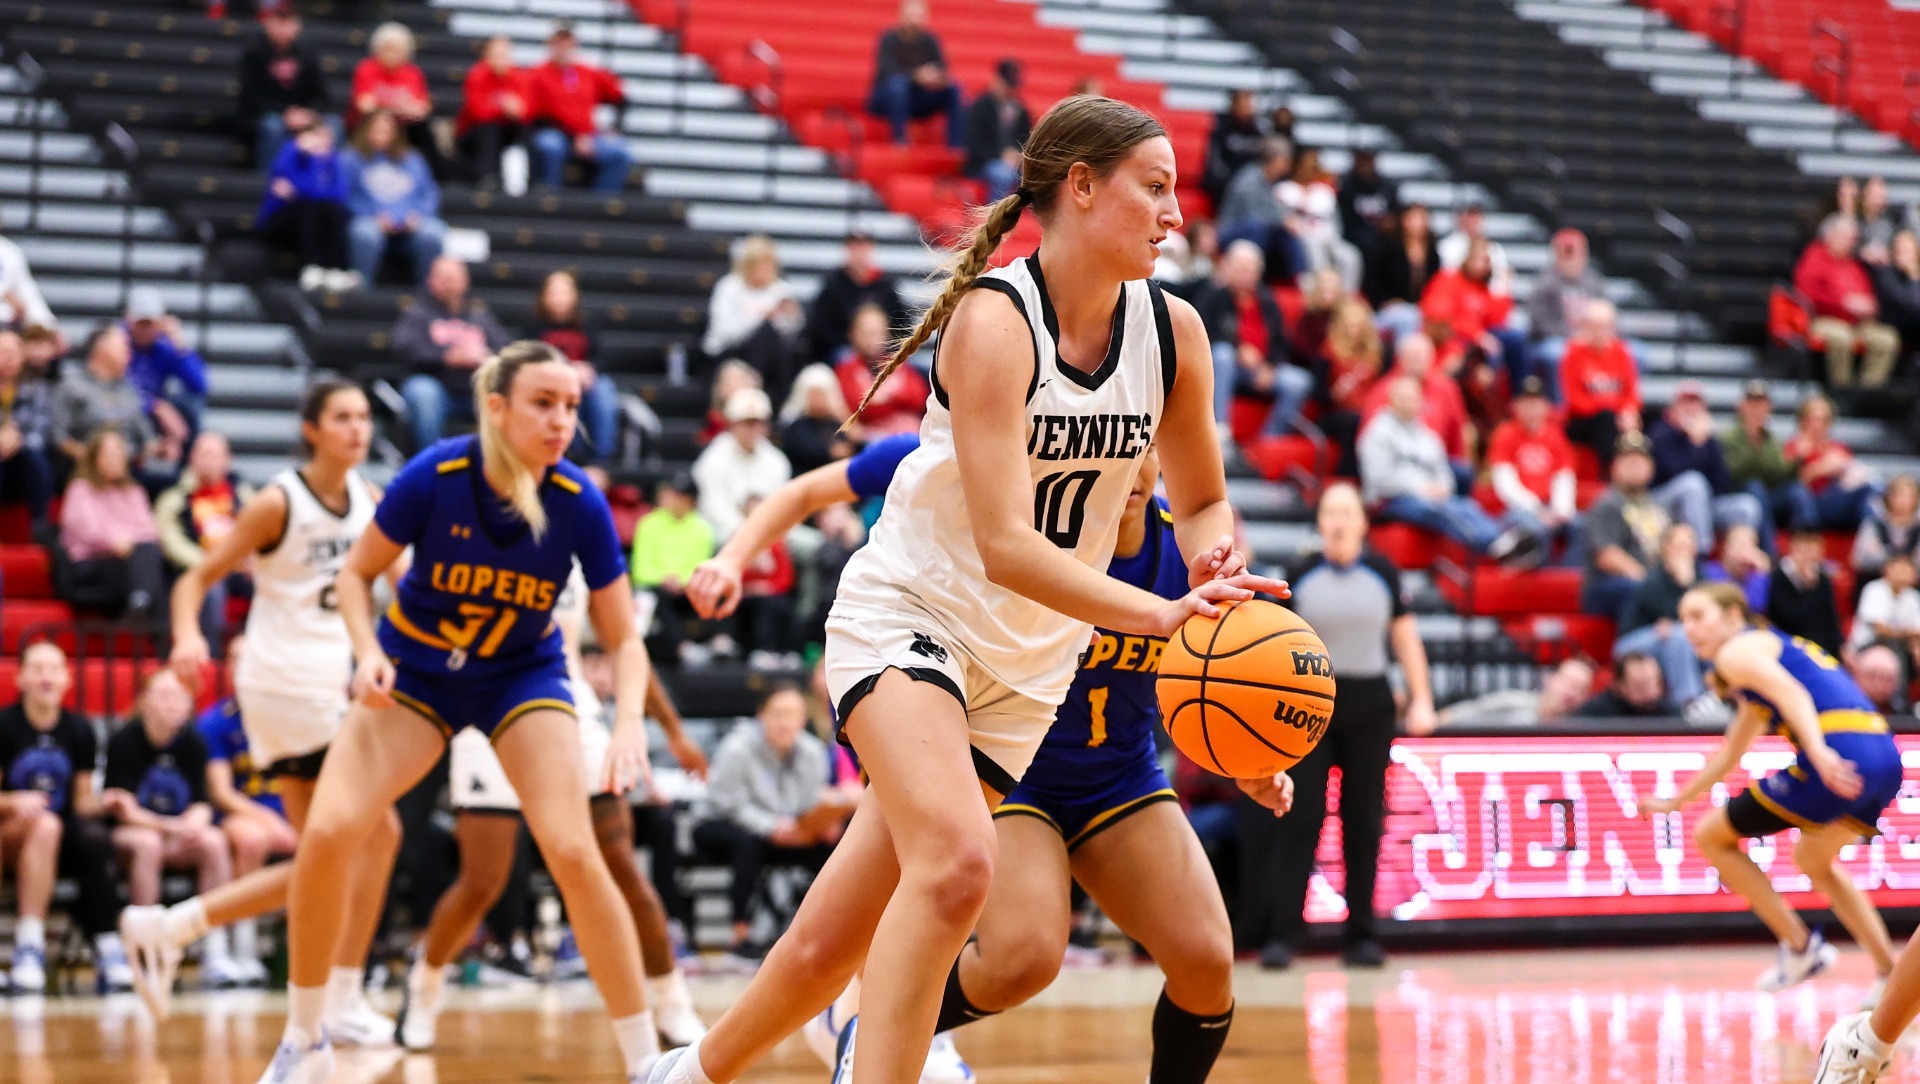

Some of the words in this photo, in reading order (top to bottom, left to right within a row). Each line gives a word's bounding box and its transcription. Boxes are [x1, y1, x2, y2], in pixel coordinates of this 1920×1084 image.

[1034, 470, 1101, 548] 10
[431, 562, 557, 611] LOPERS
[1083, 635, 1168, 672] PER
[1291, 650, 1334, 680] CAA
[1087, 686, 1109, 747] 1
[1273, 700, 1328, 743] ilson
